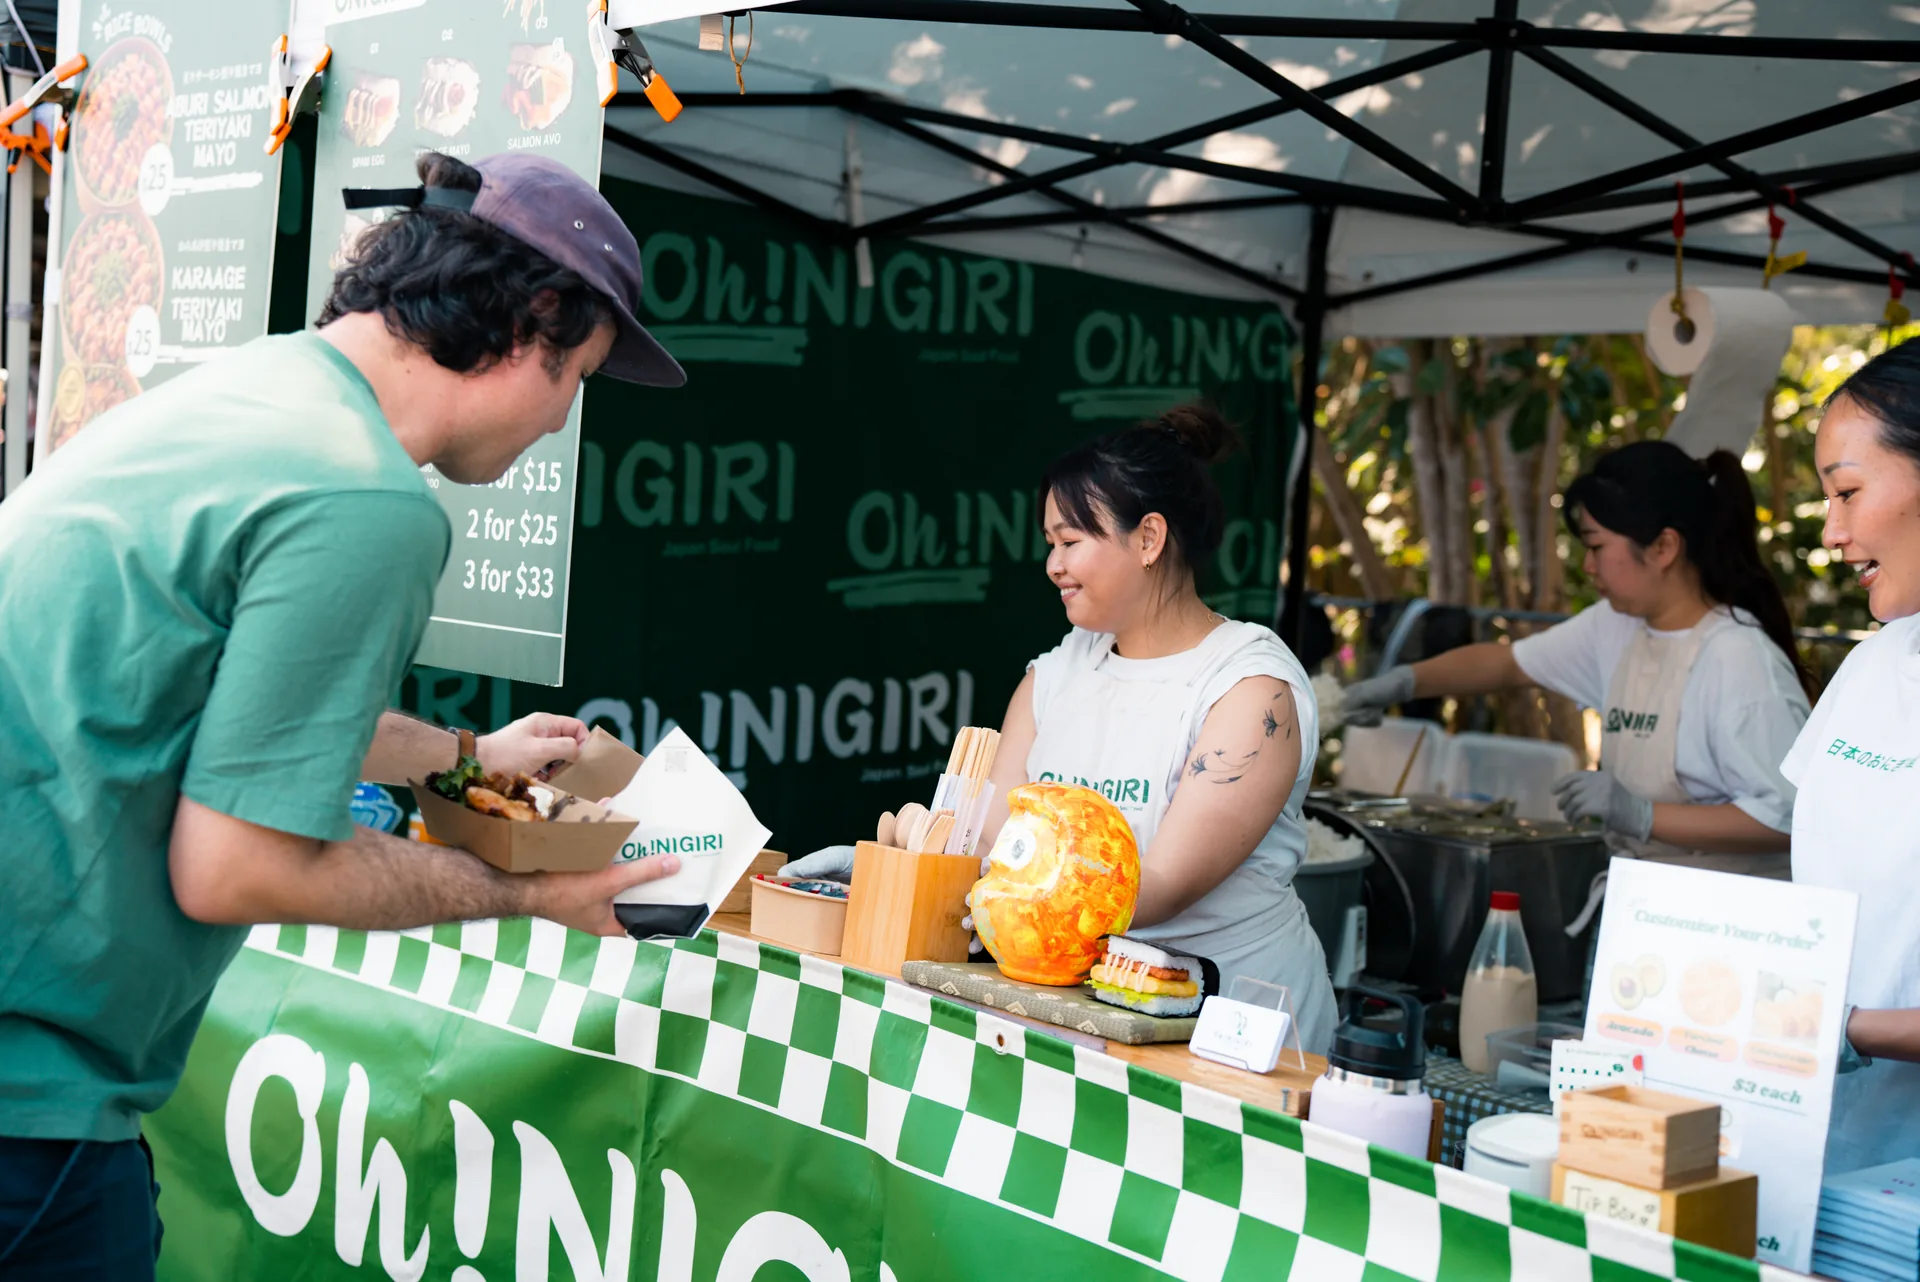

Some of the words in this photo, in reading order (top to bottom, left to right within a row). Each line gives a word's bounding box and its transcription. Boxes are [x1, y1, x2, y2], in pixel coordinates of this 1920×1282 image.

[133, 14, 173, 54] BOWLS
[166, 92, 209, 119] ABURI
[184, 114, 252, 143] TERIYAKI
[507, 136, 542, 150] SALMON
[543, 133, 561, 146] AVO
[193, 141, 236, 169] MAYO
[171, 265, 246, 290] KARAAGE
[171, 296, 243, 321] TERIYAKI
[181, 316, 226, 343] MAYO
[522, 456, 562, 495] $15
[466, 508, 479, 538] 2
[484, 508, 515, 542] for
[518, 509, 558, 547] $25
[463, 559, 476, 589] 3
[480, 559, 512, 593] for
[515, 561, 554, 599] $33
[621, 833, 723, 860] Oh!NIGIRI
[1635, 909, 1720, 934] Customise
[1722, 922, 1766, 943] Your
[1766, 930, 1819, 951] Order
[1605, 1019, 1655, 1039] Avocado
[1732, 1077, 1756, 1095] $3
[1759, 1084, 1804, 1105] each
[225, 1034, 898, 1282] Oh!NI
